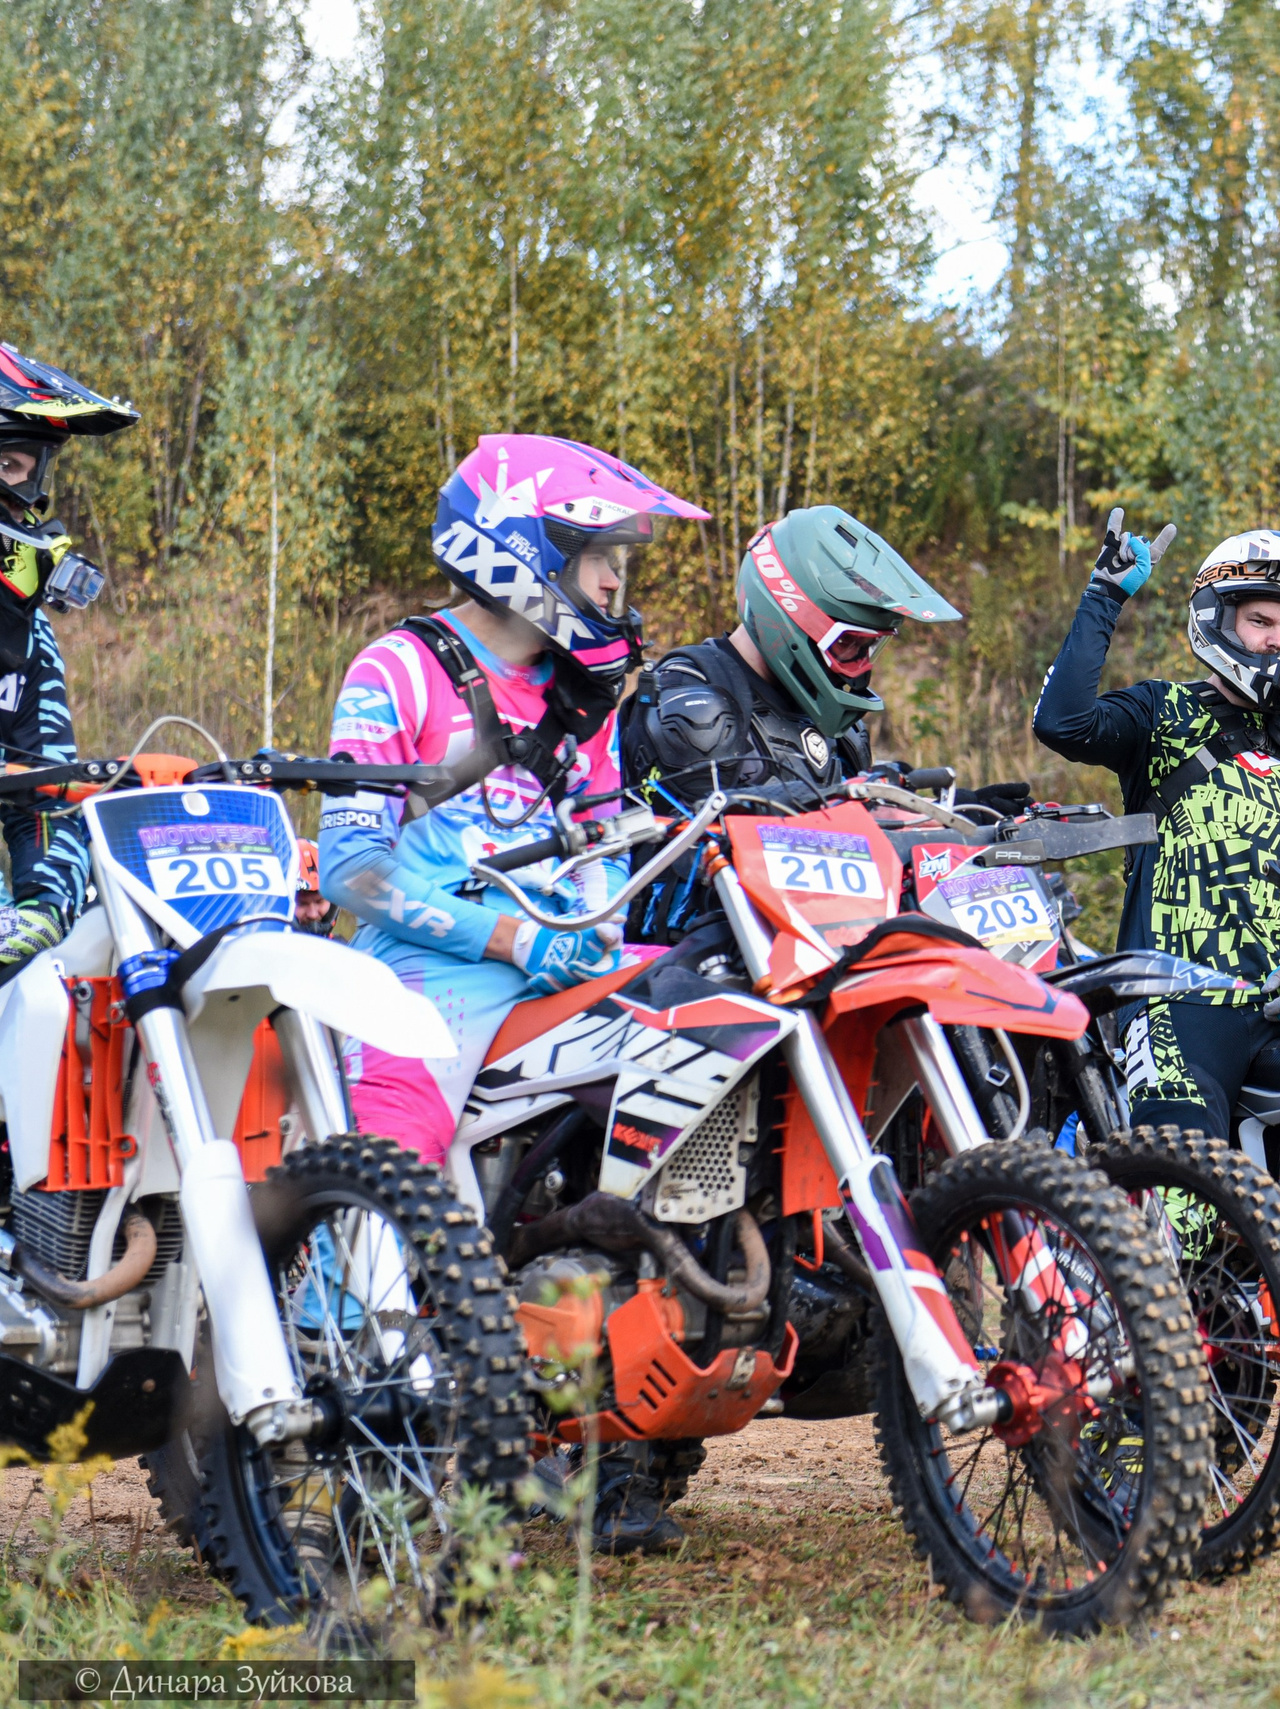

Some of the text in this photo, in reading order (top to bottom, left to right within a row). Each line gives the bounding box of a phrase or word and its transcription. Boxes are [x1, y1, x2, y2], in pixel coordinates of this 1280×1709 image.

[139, 825, 268, 849] MOTOFEST
[758, 825, 867, 853] MOTOFEST
[168, 856, 270, 895] 205
[780, 855, 867, 894] 210
[938, 866, 1027, 900] MOTOFEST
[966, 894, 1038, 938] 203
